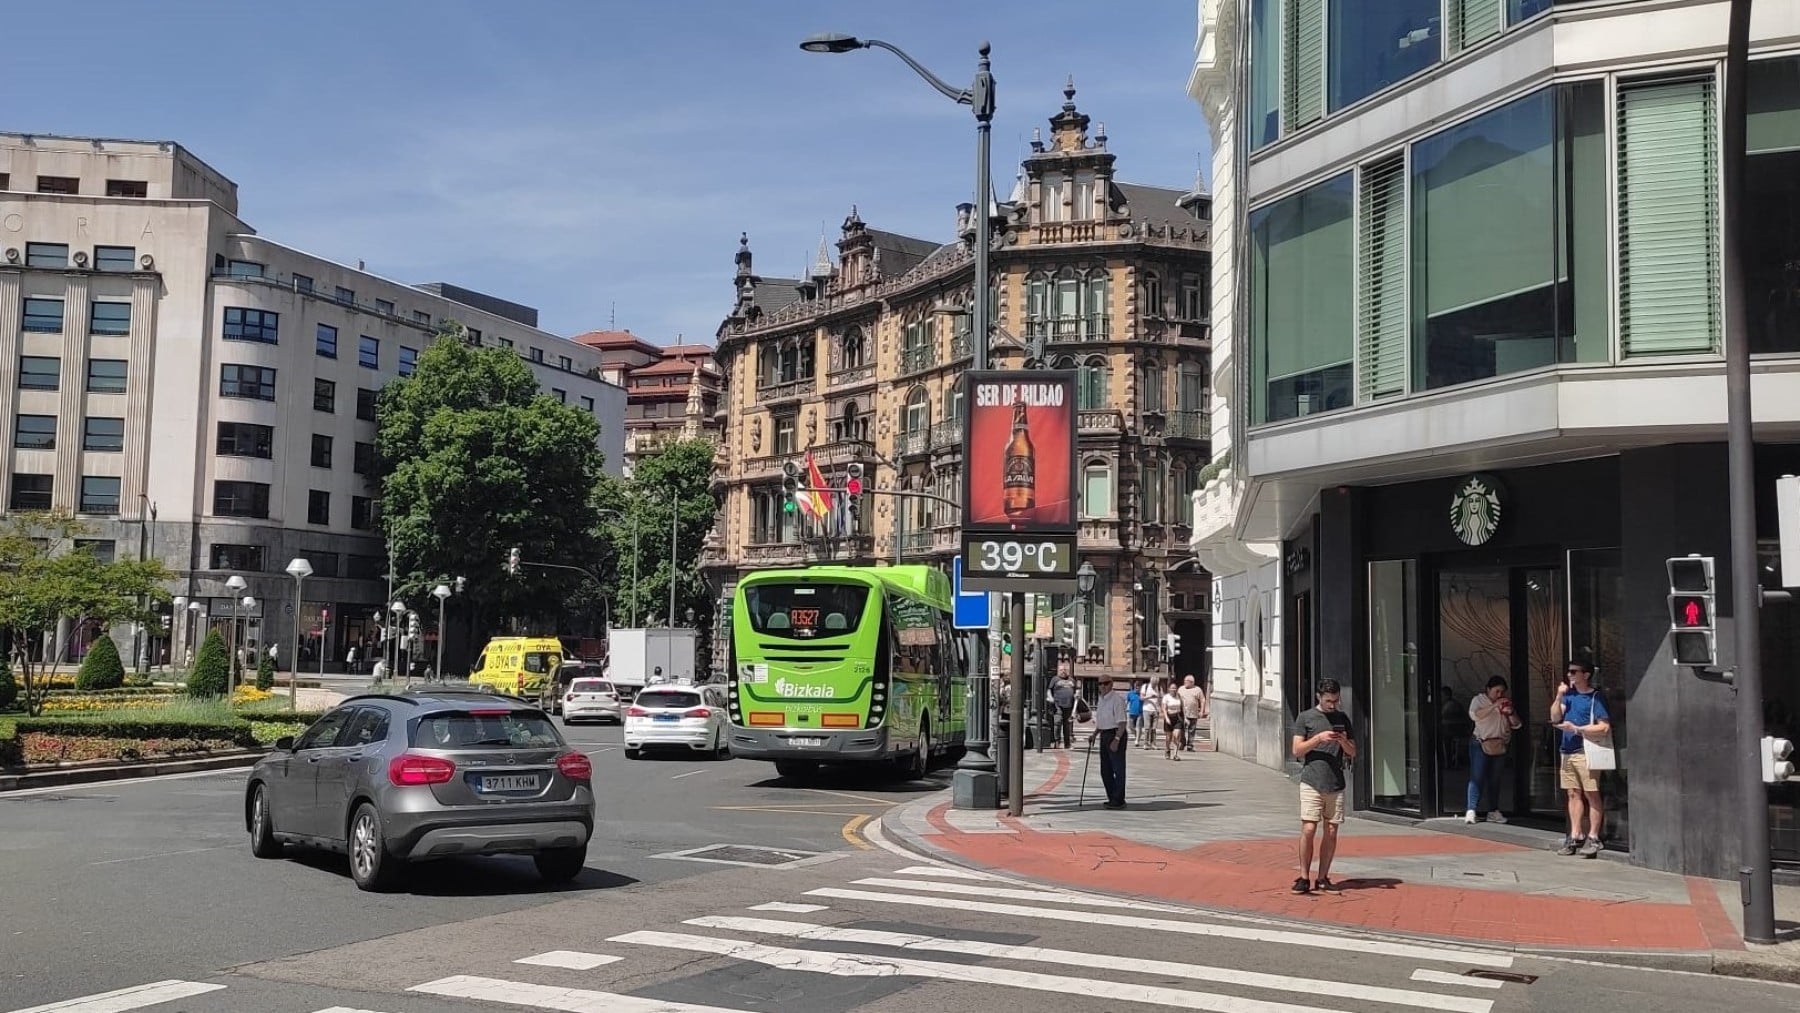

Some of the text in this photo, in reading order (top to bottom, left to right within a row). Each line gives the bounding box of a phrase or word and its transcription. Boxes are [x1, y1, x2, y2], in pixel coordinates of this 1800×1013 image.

[977, 384, 1064, 407] SER DE BILBAO
[980, 541, 1057, 572] 39°C
[784, 682, 834, 698] Bizkaia
[485, 775, 536, 789] 3711 KHM
